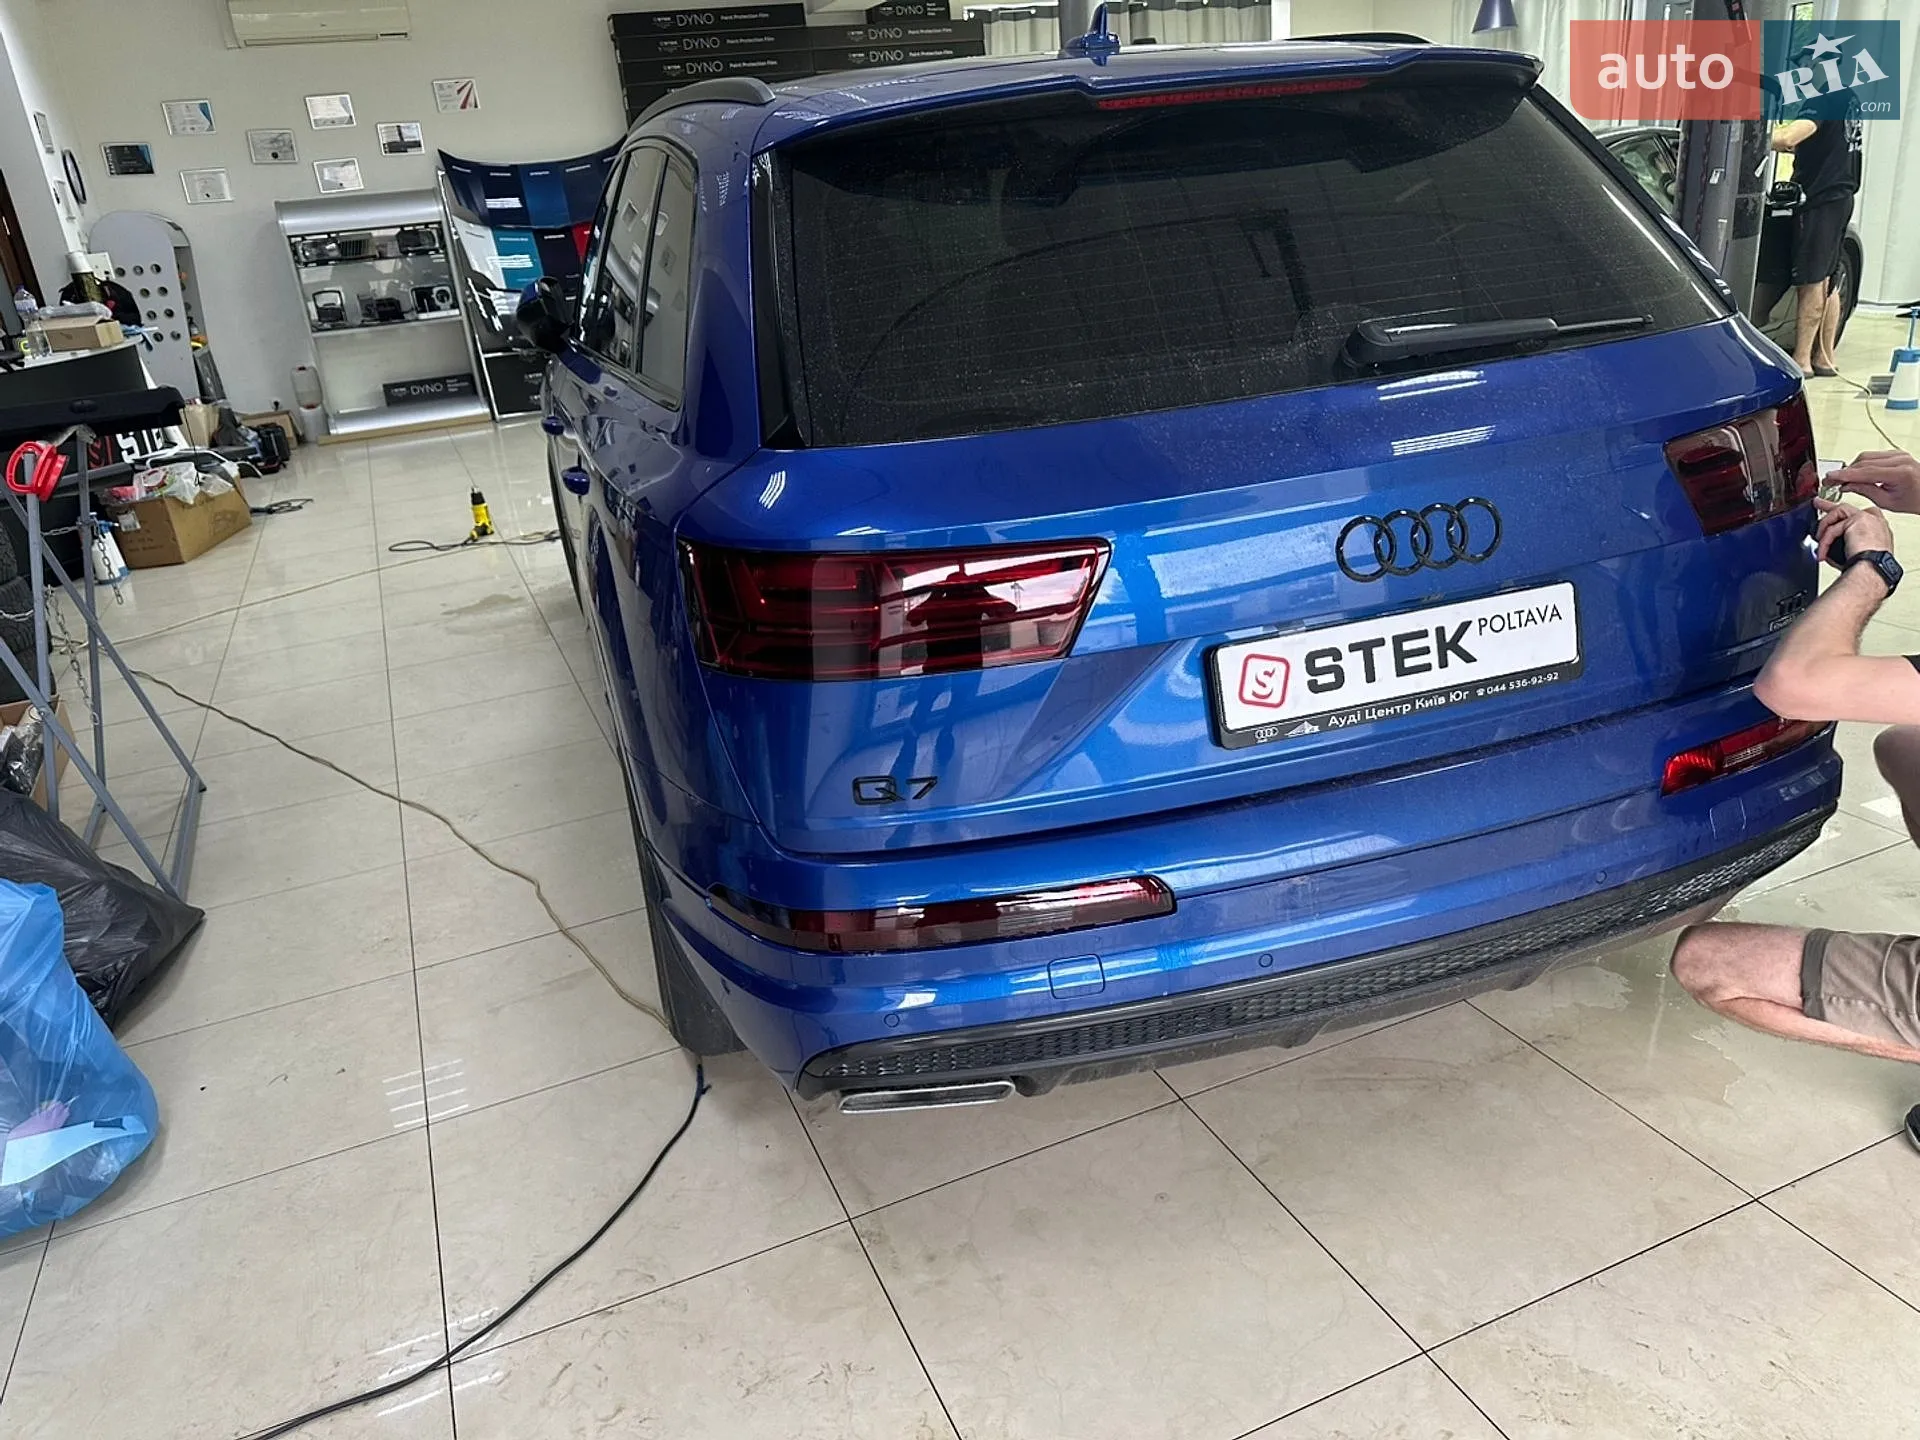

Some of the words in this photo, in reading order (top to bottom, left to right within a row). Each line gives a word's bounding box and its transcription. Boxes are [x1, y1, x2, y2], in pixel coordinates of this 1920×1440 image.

[896, 5, 924, 16] DYNO
[676, 13, 714, 27] DYNO
[868, 27, 902, 40] DYNO
[683, 37, 720, 51] DYNO
[869, 50, 904, 63] DYNO
[686, 60, 723, 74] DYNO
[410, 382, 444, 396] DYNO
[1304, 619, 1478, 695] STEK
[1477, 604, 1563, 637] POLTAVA
[1327, 711, 1362, 729] Ауді
[1364, 701, 1412, 724] Центр
[1414, 694, 1446, 710] Київ
[1449, 688, 1470, 703] Юг
[1486, 685, 1507, 697] 044
[1508, 671, 1560, 690] 536-92-92
